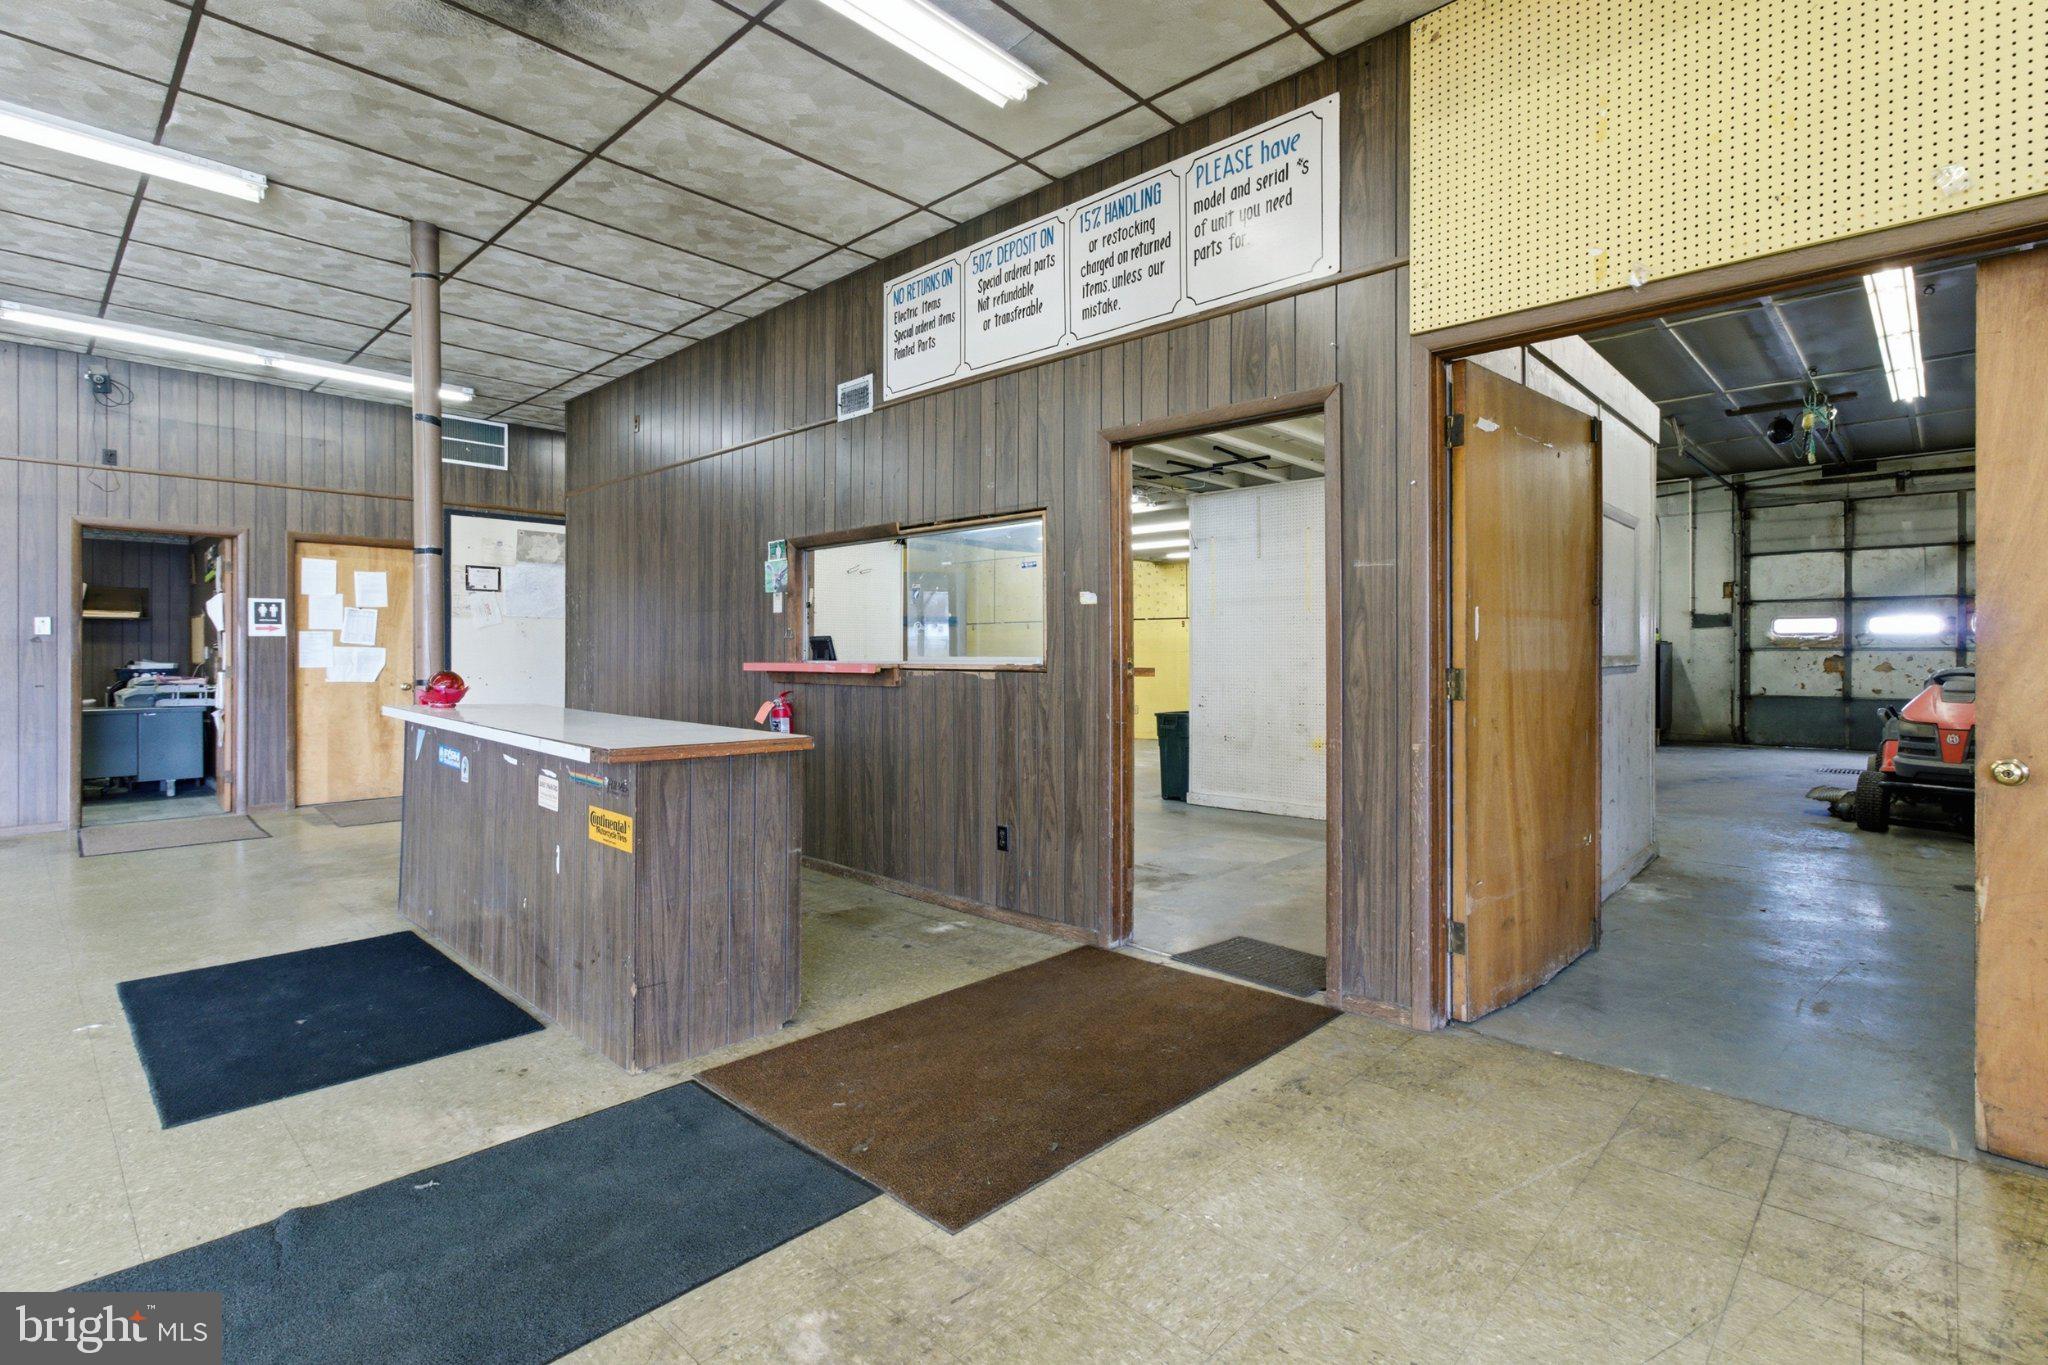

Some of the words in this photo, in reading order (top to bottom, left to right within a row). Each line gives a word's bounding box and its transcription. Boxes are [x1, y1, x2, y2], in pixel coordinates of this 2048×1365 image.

[1196, 144, 1253, 188] PLEASE
[1261, 133, 1301, 164] have
[1193, 186, 1225, 215] model
[1230, 177, 1251, 200] and
[1256, 162, 1289, 191] serial
[1079, 206, 1102, 233] 15%
[1104, 182, 1162, 224] HANDLING
[1194, 218, 1208, 238] of
[1211, 209, 1234, 232] unit
[1239, 202, 1261, 228] you
[1265, 187, 1293, 213] need
[972, 249, 994, 275] 50%
[996, 231, 1038, 266] DEPOSIT
[1040, 225, 1055, 249] ON
[1088, 238, 1099, 253] or
[1102, 217, 1156, 247] restocking
[1080, 251, 1115, 278] charged
[1117, 250, 1129, 265] on
[1130, 231, 1172, 260] returned
[1194, 240, 1222, 267] parts
[893, 287, 905, 307] NO
[906, 271, 941, 302] RETURNS
[941, 267, 954, 287] ON
[977, 267, 1003, 295] Special
[1004, 258, 1031, 283] ordered
[1034, 253, 1056, 276] parts
[1112, 268, 1143, 290] unless
[1147, 260, 1166, 278] our
[893, 306, 919, 325] Electric
[921, 298, 942, 315] Items
[977, 296, 991, 313] Not
[992, 281, 1034, 307] refundable
[982, 318, 992, 331] or
[993, 297, 1044, 327] transferable
[1082, 298, 1121, 320] mistake.
[893, 323, 914, 345] Special
[914, 315, 936, 336] ordered
[937, 311, 956, 326] items
[893, 341, 916, 361] Painted
[917, 336, 936, 353] Parts
[590, 811, 627, 834] Continental
